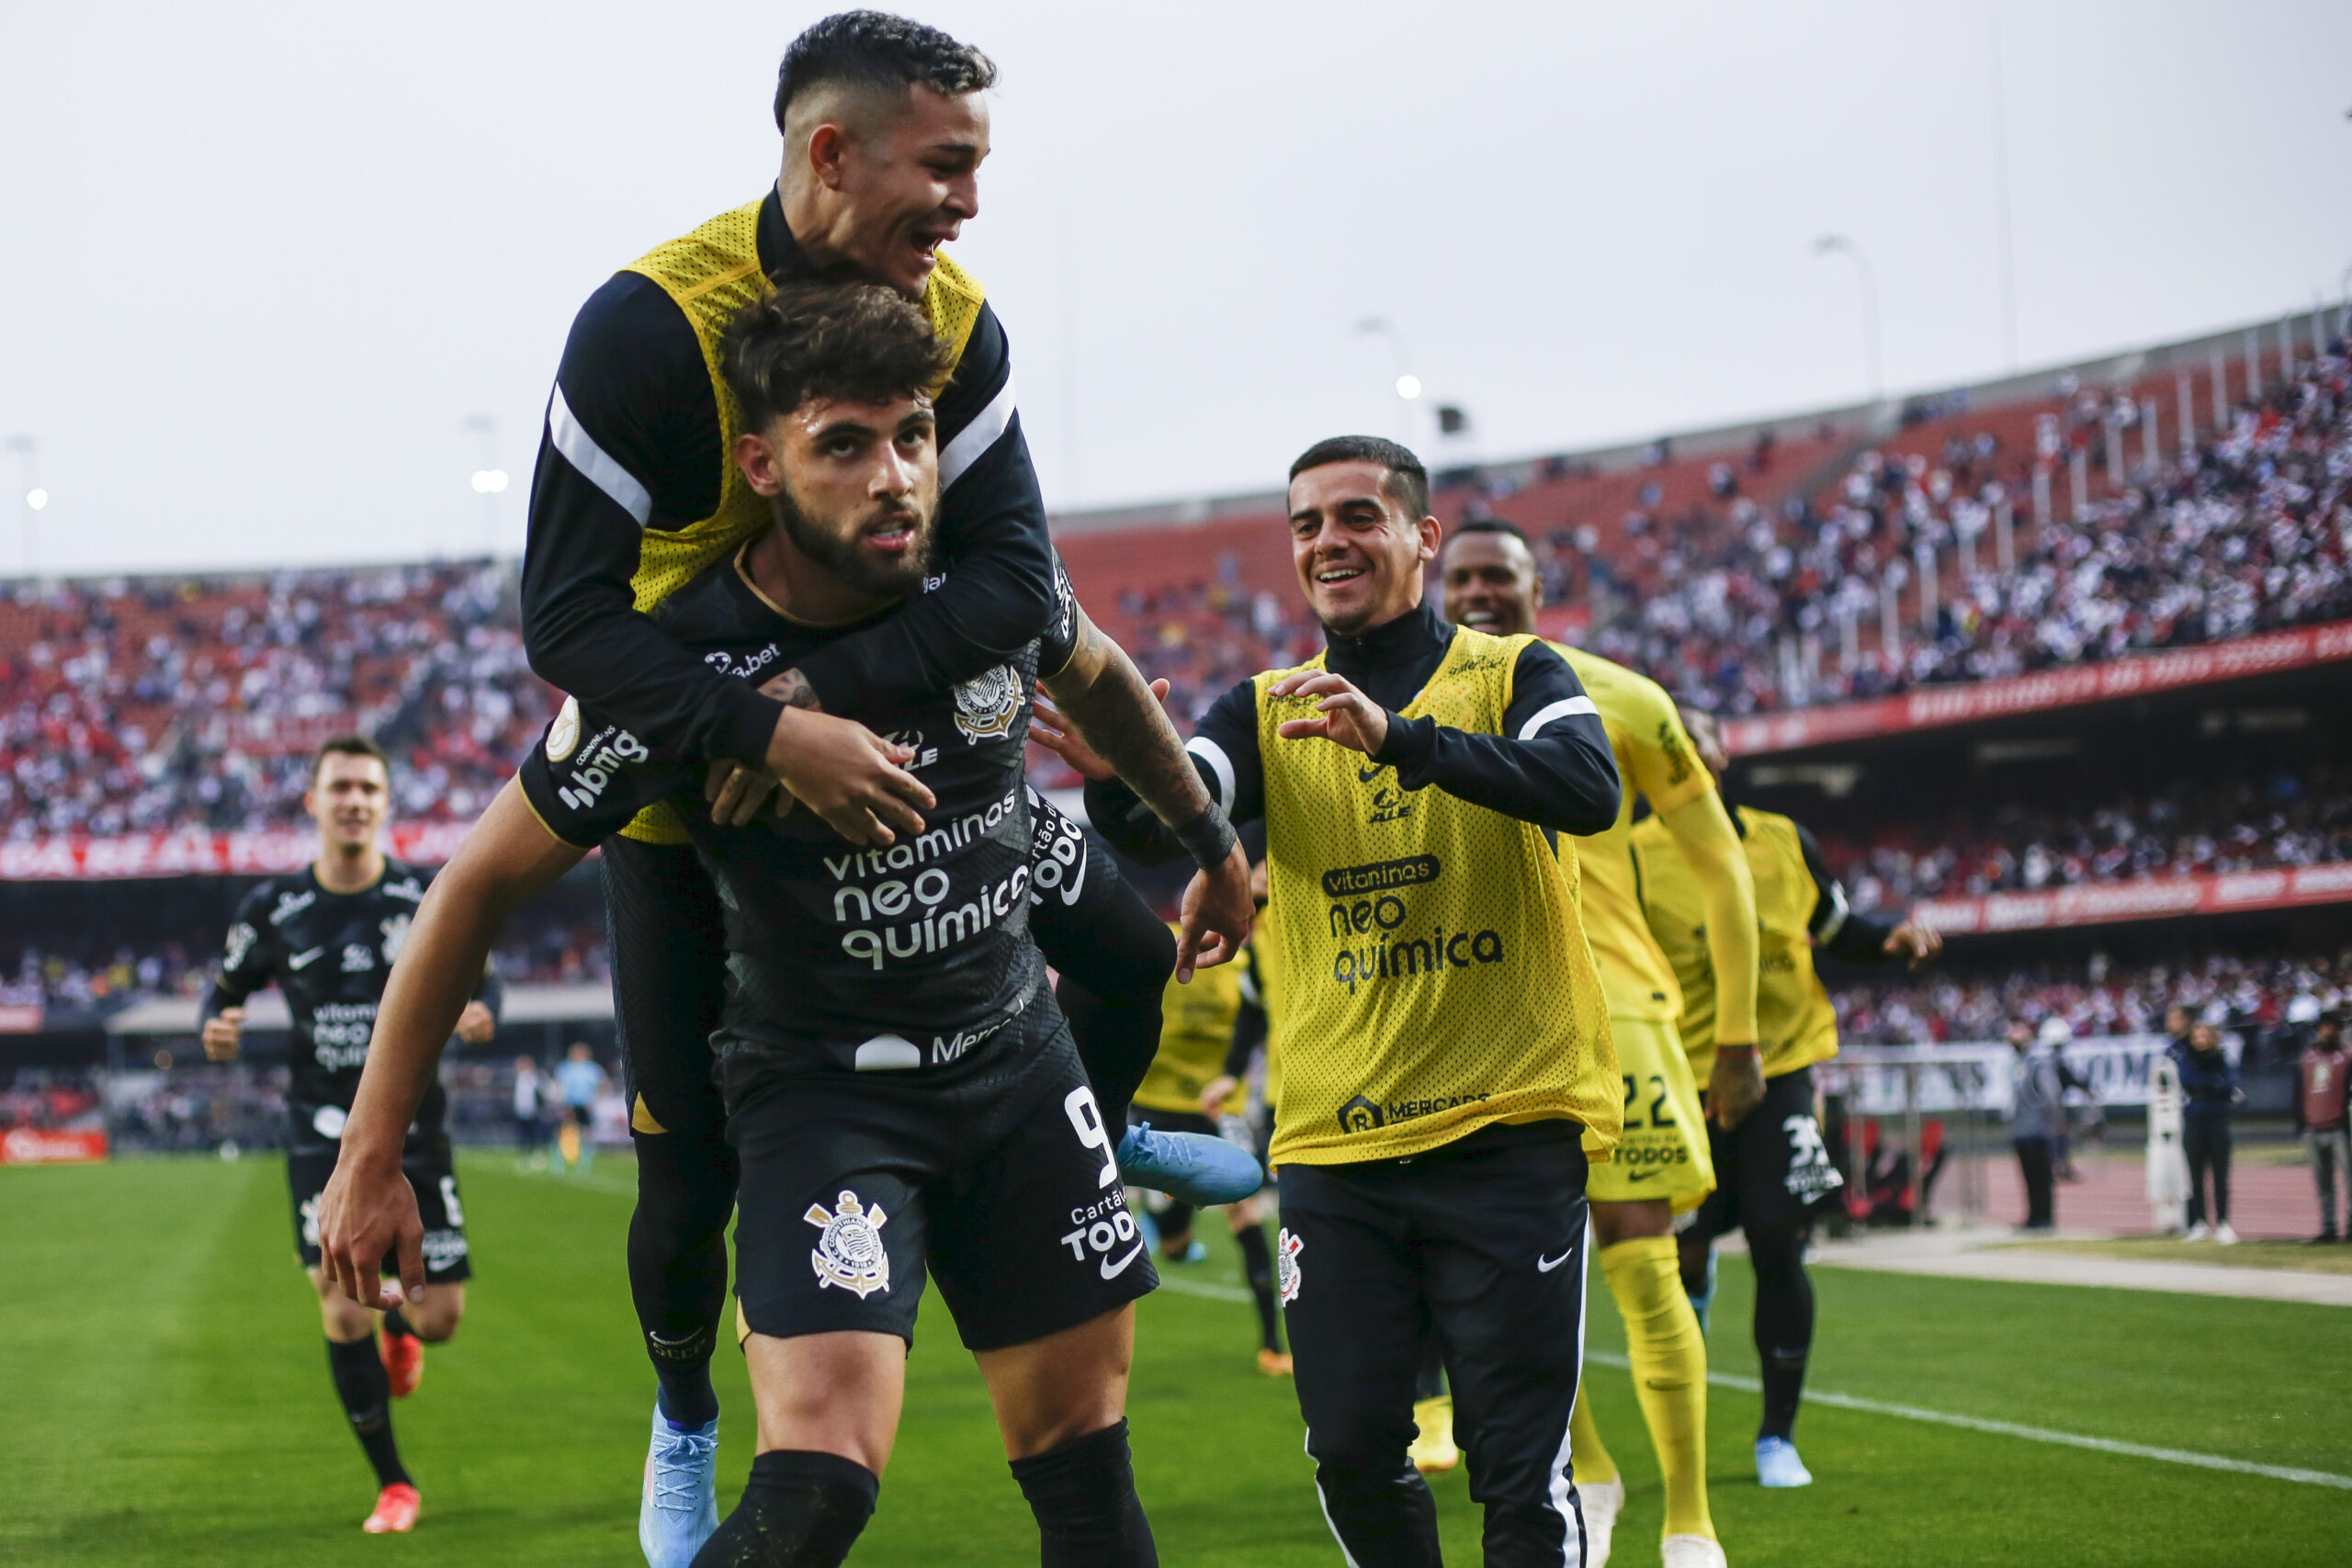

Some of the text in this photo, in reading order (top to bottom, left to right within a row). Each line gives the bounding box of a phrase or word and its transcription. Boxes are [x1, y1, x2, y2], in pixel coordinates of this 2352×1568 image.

[570, 728, 649, 796] bmg
[575, 724, 616, 766] CORINTHIANS
[823, 788, 1015, 881] vitaminas
[833, 867, 950, 922] neo
[1329, 860, 1430, 892] vitaminas
[841, 864, 1029, 971] química
[1329, 895, 1407, 938] neo
[1333, 925, 1504, 996] química
[1623, 1075, 1677, 1129] 22
[1064, 1085, 1118, 1190] 9
[1613, 1145, 1690, 1165] TODOS
